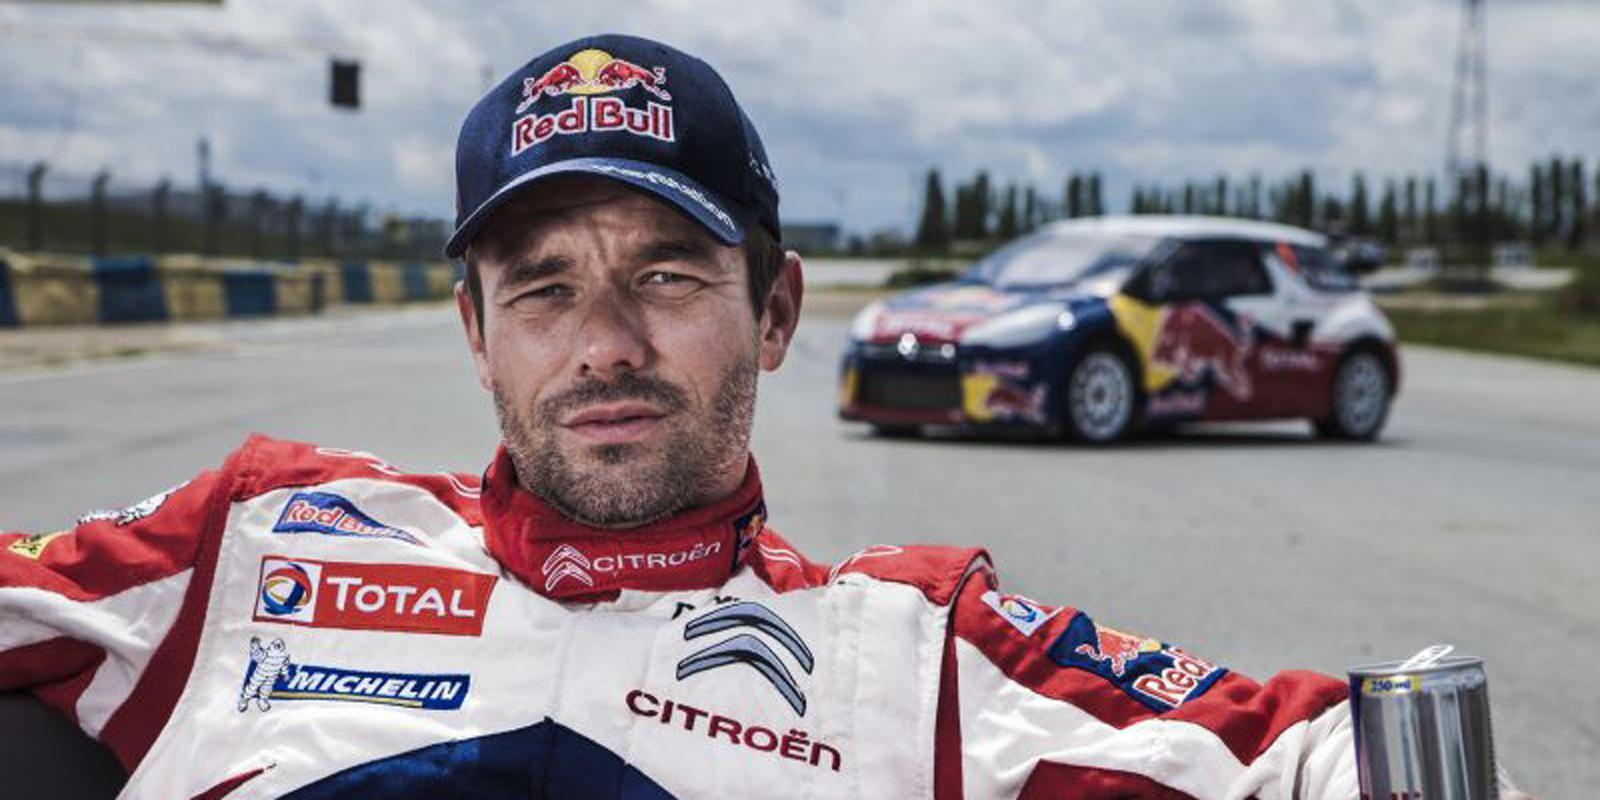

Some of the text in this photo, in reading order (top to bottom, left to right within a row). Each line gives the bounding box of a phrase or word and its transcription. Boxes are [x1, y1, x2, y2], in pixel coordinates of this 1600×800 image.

[512, 96, 675, 157] Red Bull
[285, 499, 345, 527] Red
[326, 576, 476, 618] TOTAL
[288, 671, 462, 701] MICHELIN
[625, 689, 842, 772] CITROËN
